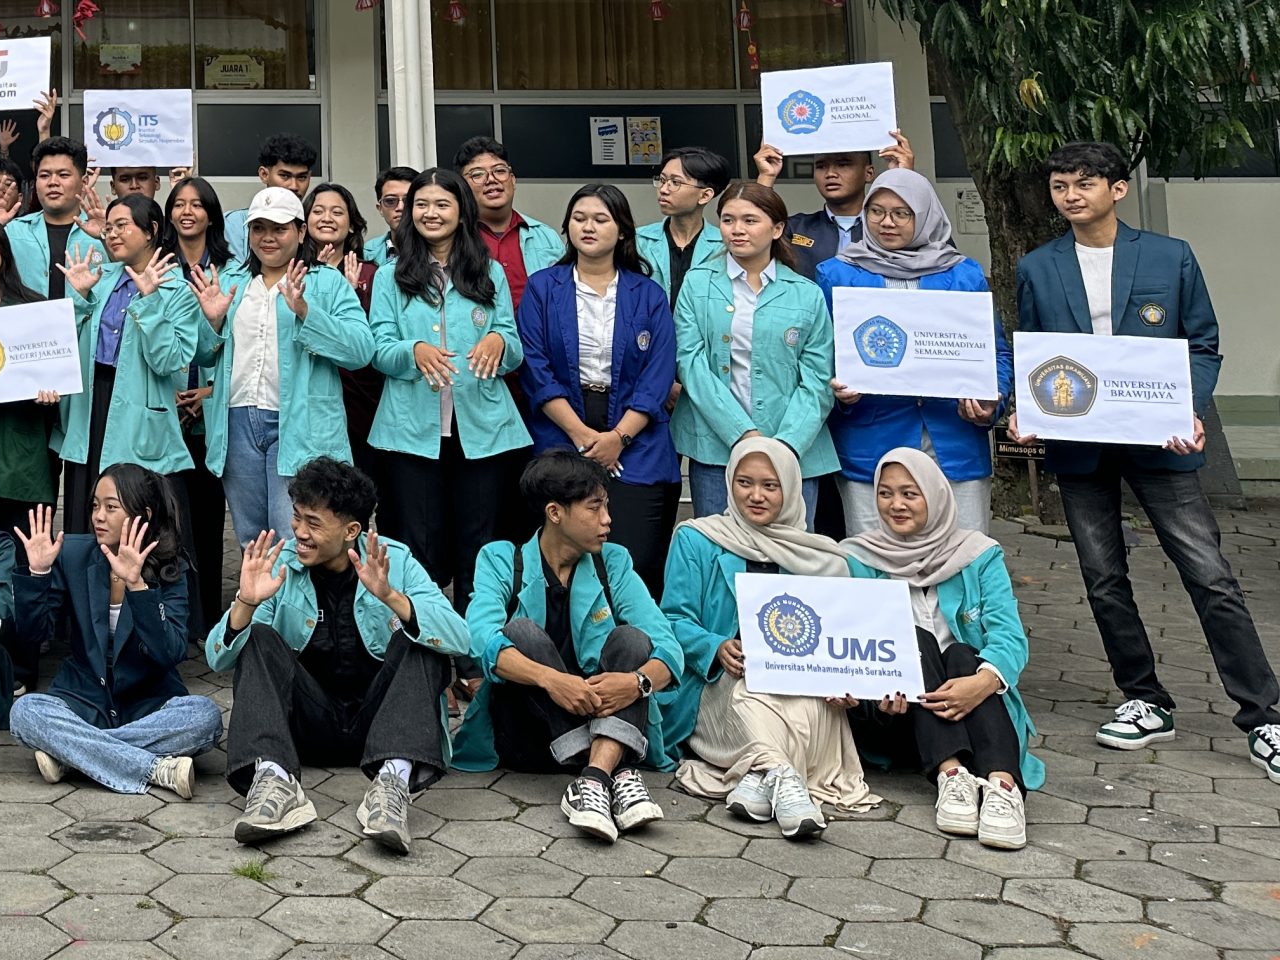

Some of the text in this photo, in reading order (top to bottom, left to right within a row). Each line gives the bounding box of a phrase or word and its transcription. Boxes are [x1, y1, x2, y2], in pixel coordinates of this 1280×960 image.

[220, 64, 244, 73] JUARA
[829, 96, 867, 104] AKADEMI
[830, 104, 877, 113] PELAYARAN
[831, 112, 872, 120] NASIONAL
[913, 331, 968, 339] UNIVERSITAS
[8, 340, 58, 352] UNIVERSITAS
[914, 340, 986, 349] MUHAMMADIYAH
[9, 347, 73, 361] NEGERI JAKARTA
[914, 348, 961, 356] SEMARANG
[1035, 364, 1092, 389] UNIVERSITAS BRAWIJAYA
[1103, 380, 1177, 390] UNIVERSITAS
[1110, 389, 1174, 400] BRAWIJAYA
[999, 444, 1037, 456] Mimusops
[763, 601, 781, 636] UNIVERSITAS
[772, 641, 811, 654] SURAKARTA
[826, 636, 897, 663] UMS
[765, 661, 903, 678] Universitas Muhammadiyah Surakarta
